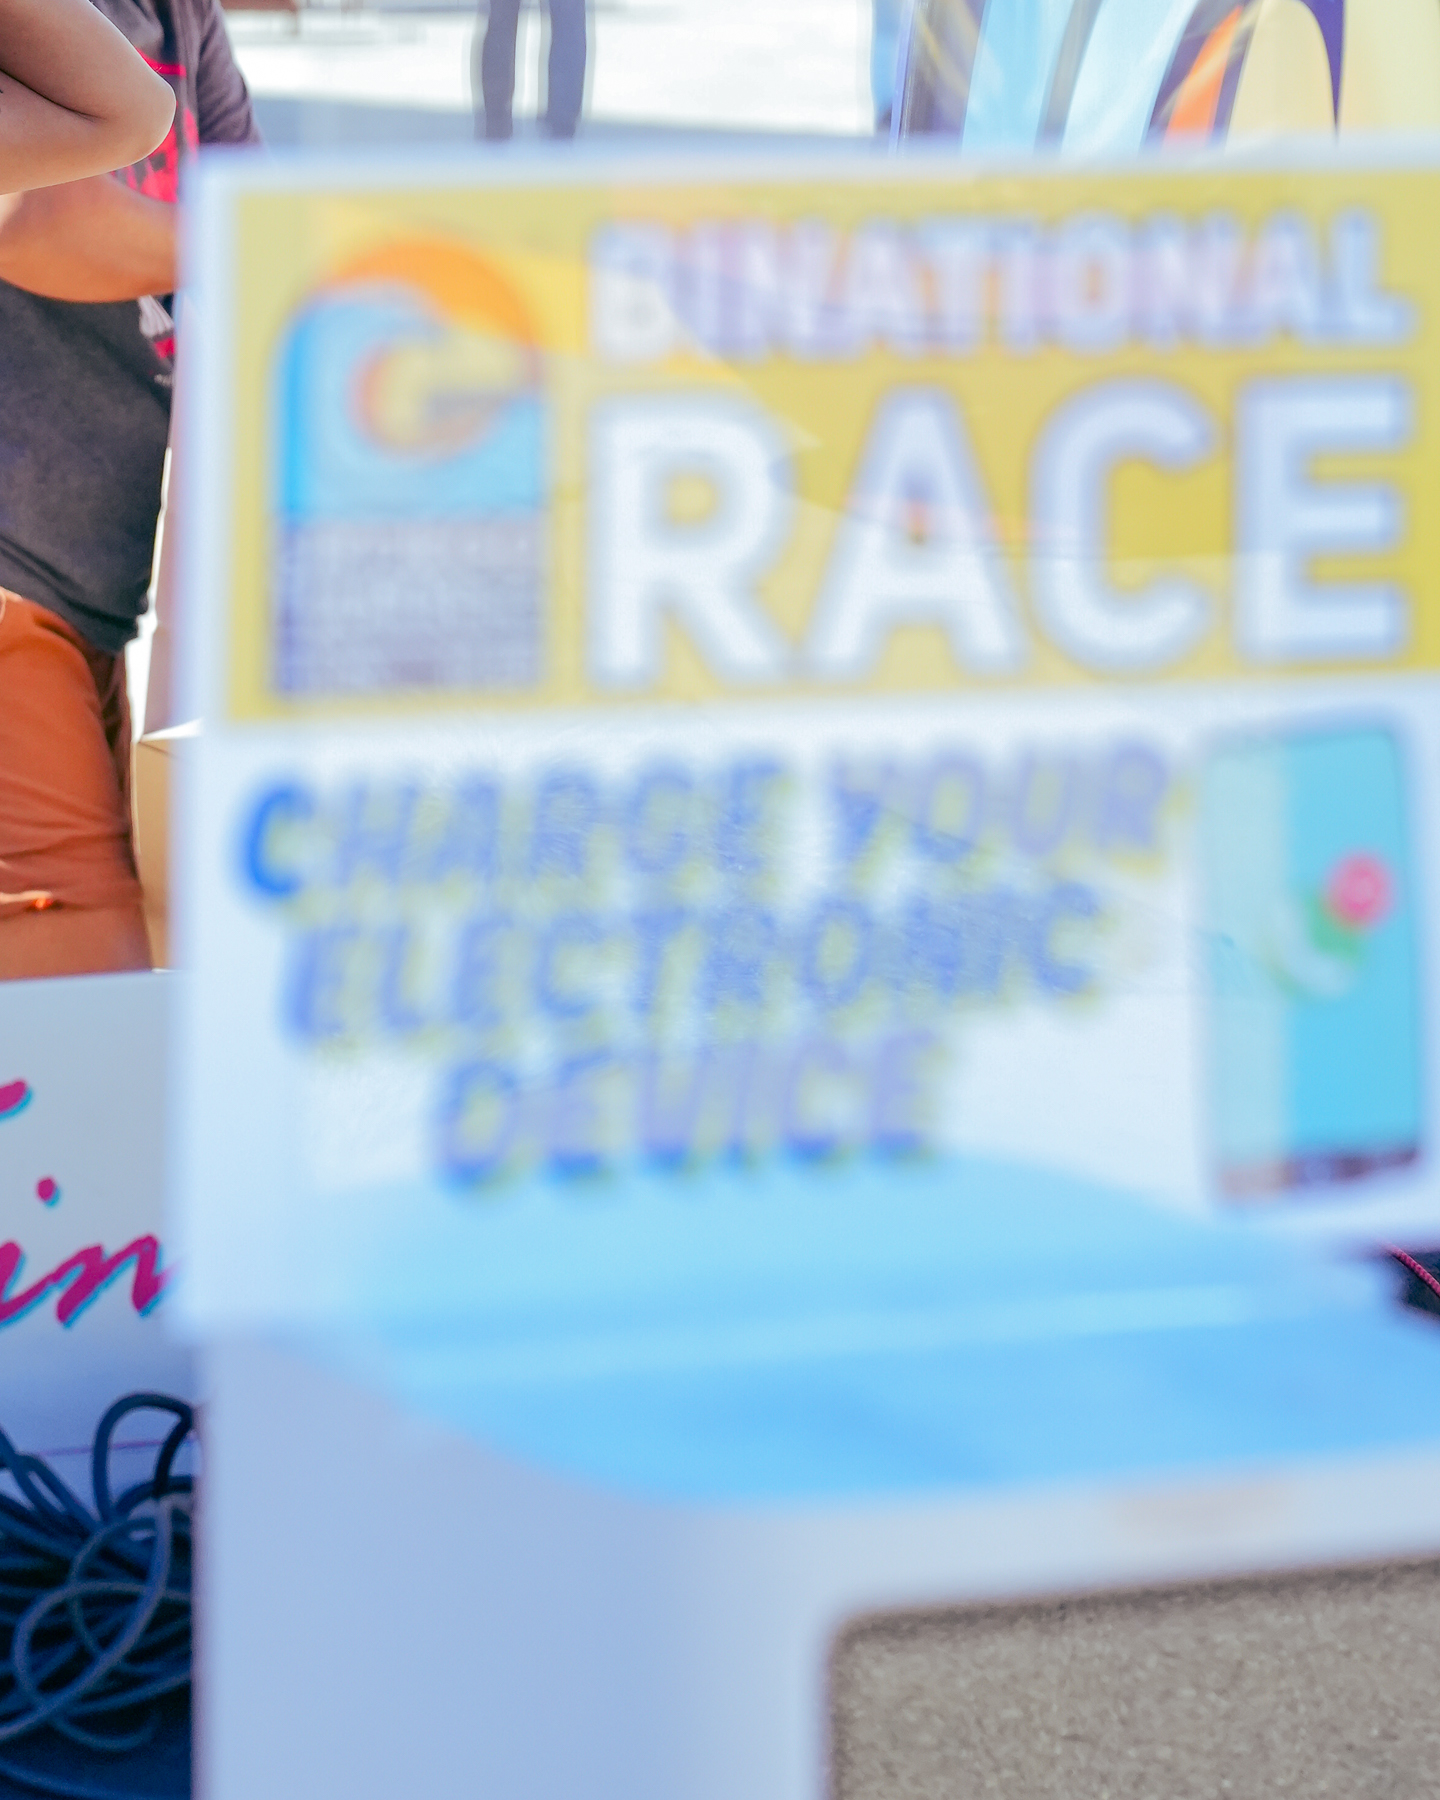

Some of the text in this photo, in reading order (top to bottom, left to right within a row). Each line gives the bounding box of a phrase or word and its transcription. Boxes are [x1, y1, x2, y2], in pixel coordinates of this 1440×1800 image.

[592, 214, 1410, 360] BINATIONAL
[592, 378, 1408, 686] RACE
[236, 744, 1166, 902] CHARGE YOUR
[436, 1032, 938, 1194] DEVICE
